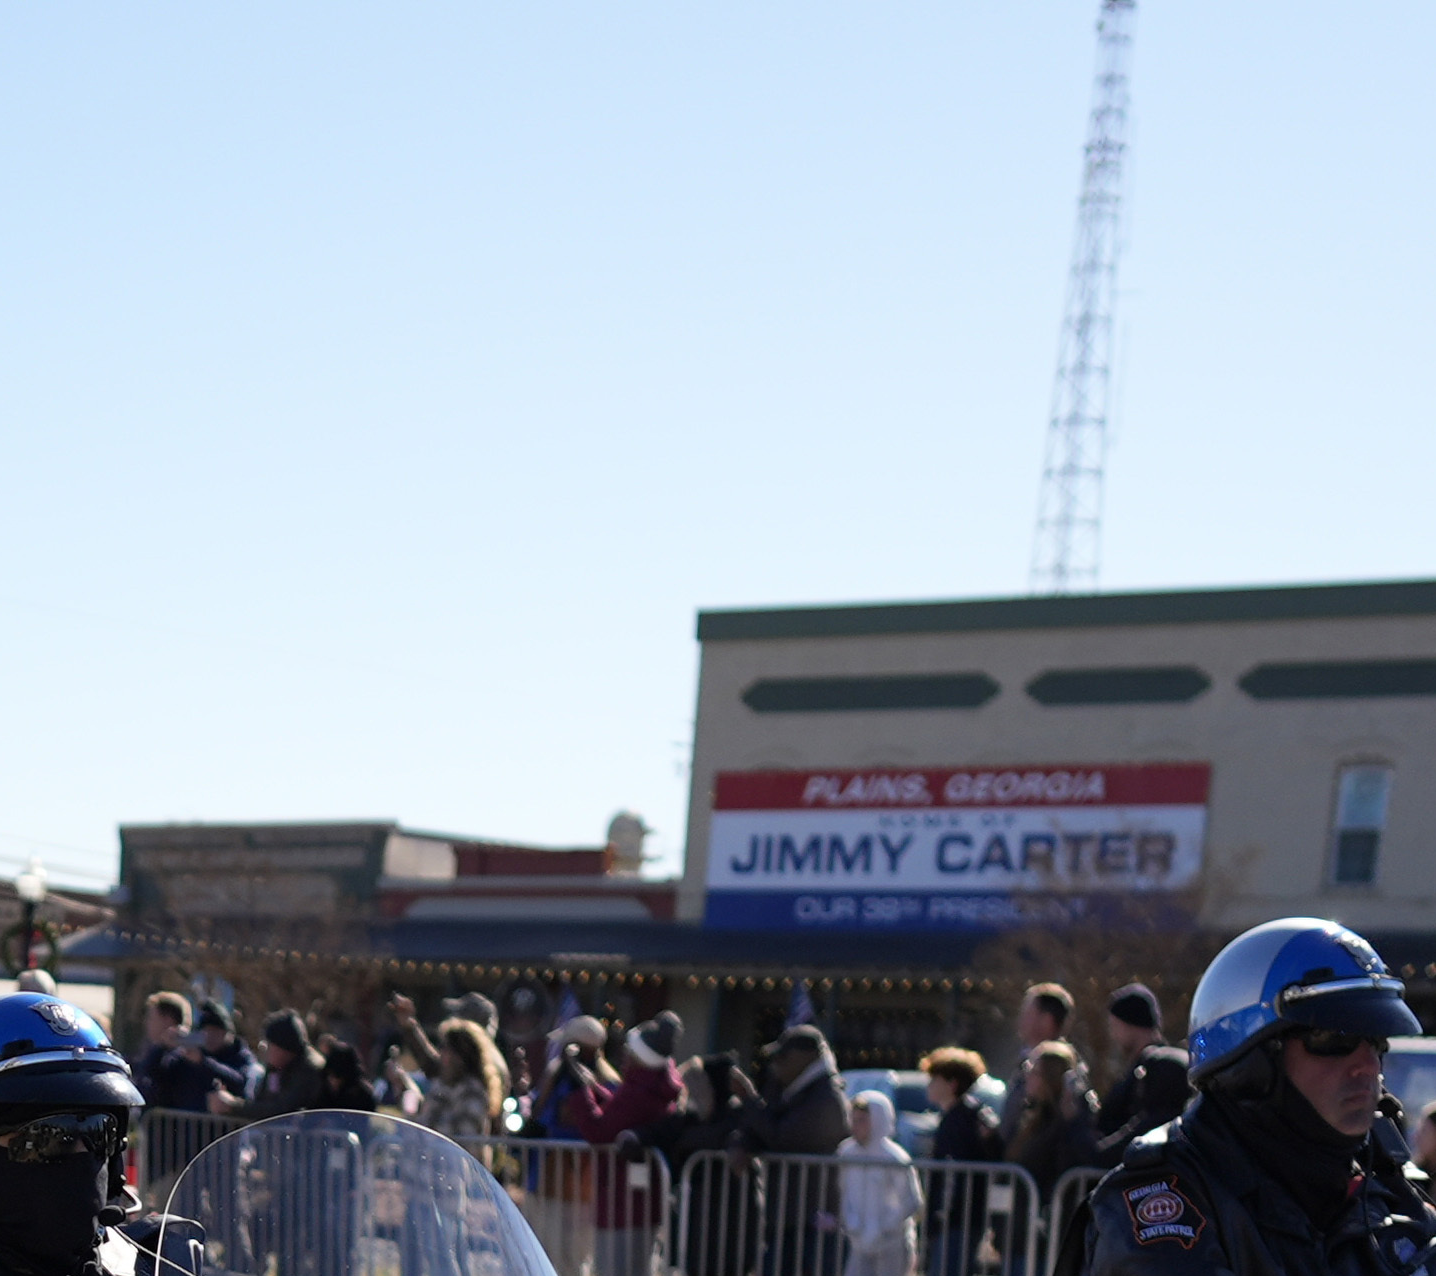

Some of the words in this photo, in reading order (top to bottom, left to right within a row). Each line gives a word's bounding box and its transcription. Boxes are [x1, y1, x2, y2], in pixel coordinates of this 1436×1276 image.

[943, 770, 1106, 801] GEORGIA
[878, 813, 962, 829] HOME
[981, 812, 1018, 828] OF
[730, 833, 915, 875] JIMMY
[934, 832, 1178, 876] CARTER
[793, 896, 857, 921] OUR
